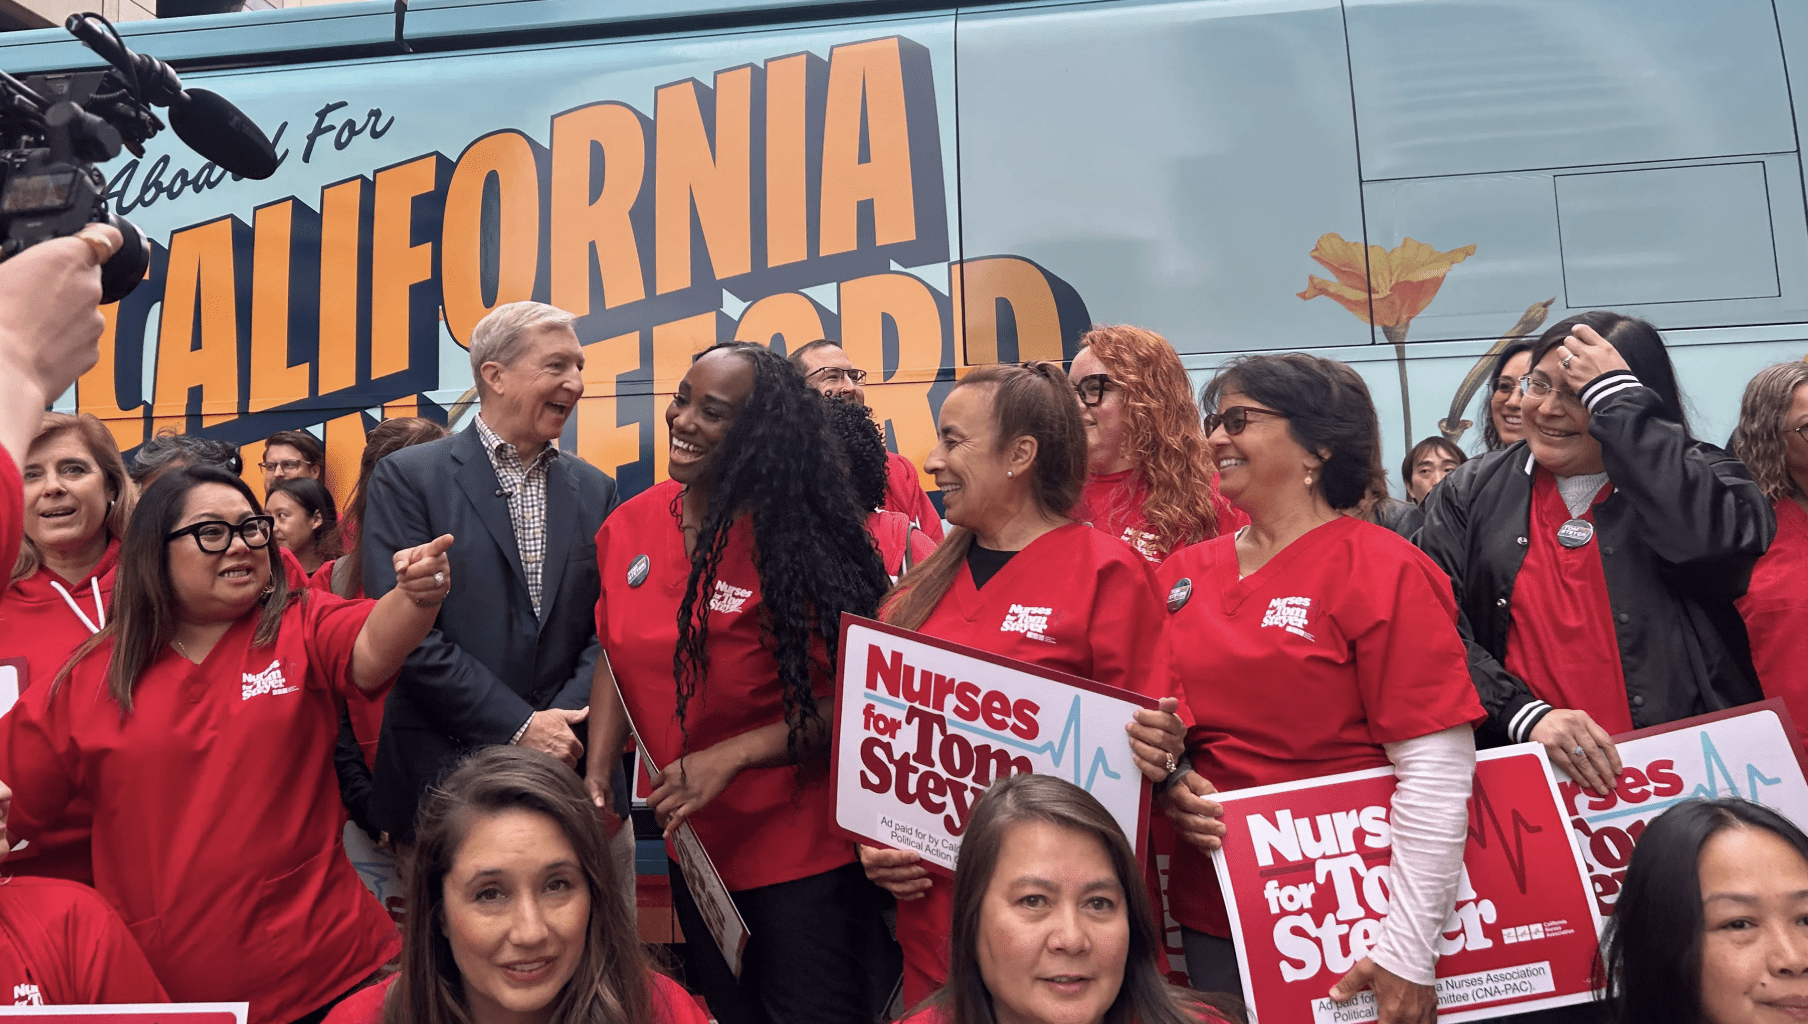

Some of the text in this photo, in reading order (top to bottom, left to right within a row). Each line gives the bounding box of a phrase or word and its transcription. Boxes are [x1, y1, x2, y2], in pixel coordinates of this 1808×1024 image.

[104, 121, 289, 216] Aboa
[302, 100, 395, 164] For
[715, 580, 753, 598] Nurses
[1268, 596, 1311, 608] Nurses
[1009, 604, 1053, 615] Nurses
[1017, 613, 1048, 624] Tom
[1261, 615, 1309, 628] Steyer
[1276, 606, 1307, 618] Tom
[1000, 620, 1048, 633] Steyer
[865, 643, 1041, 741] Nurses
[863, 703, 902, 739] for
[905, 705, 1033, 788] Tom
[860, 737, 986, 837] Stey
[1557, 759, 1684, 817] rses
[881, 816, 893, 828] Ad
[895, 822, 913, 836] paid
[915, 829, 926, 840] for
[929, 834, 939, 847] by
[891, 831, 923, 851] Political
[925, 846, 952, 862] Action
[1246, 805, 1392, 867] Nurs
[1264, 880, 1316, 914] for
[1543, 919, 1568, 927] California
[1546, 929, 1575, 938] Association
[1272, 899, 1497, 983] Steer
[1319, 1000, 1333, 1012] Ad
[1361, 993, 1375, 1004] for
[1446, 977, 1484, 991] Nurses
[1486, 966, 1546, 984] Association
[1333, 980, 1536, 1022] Political mittee (CNA-PAC).
